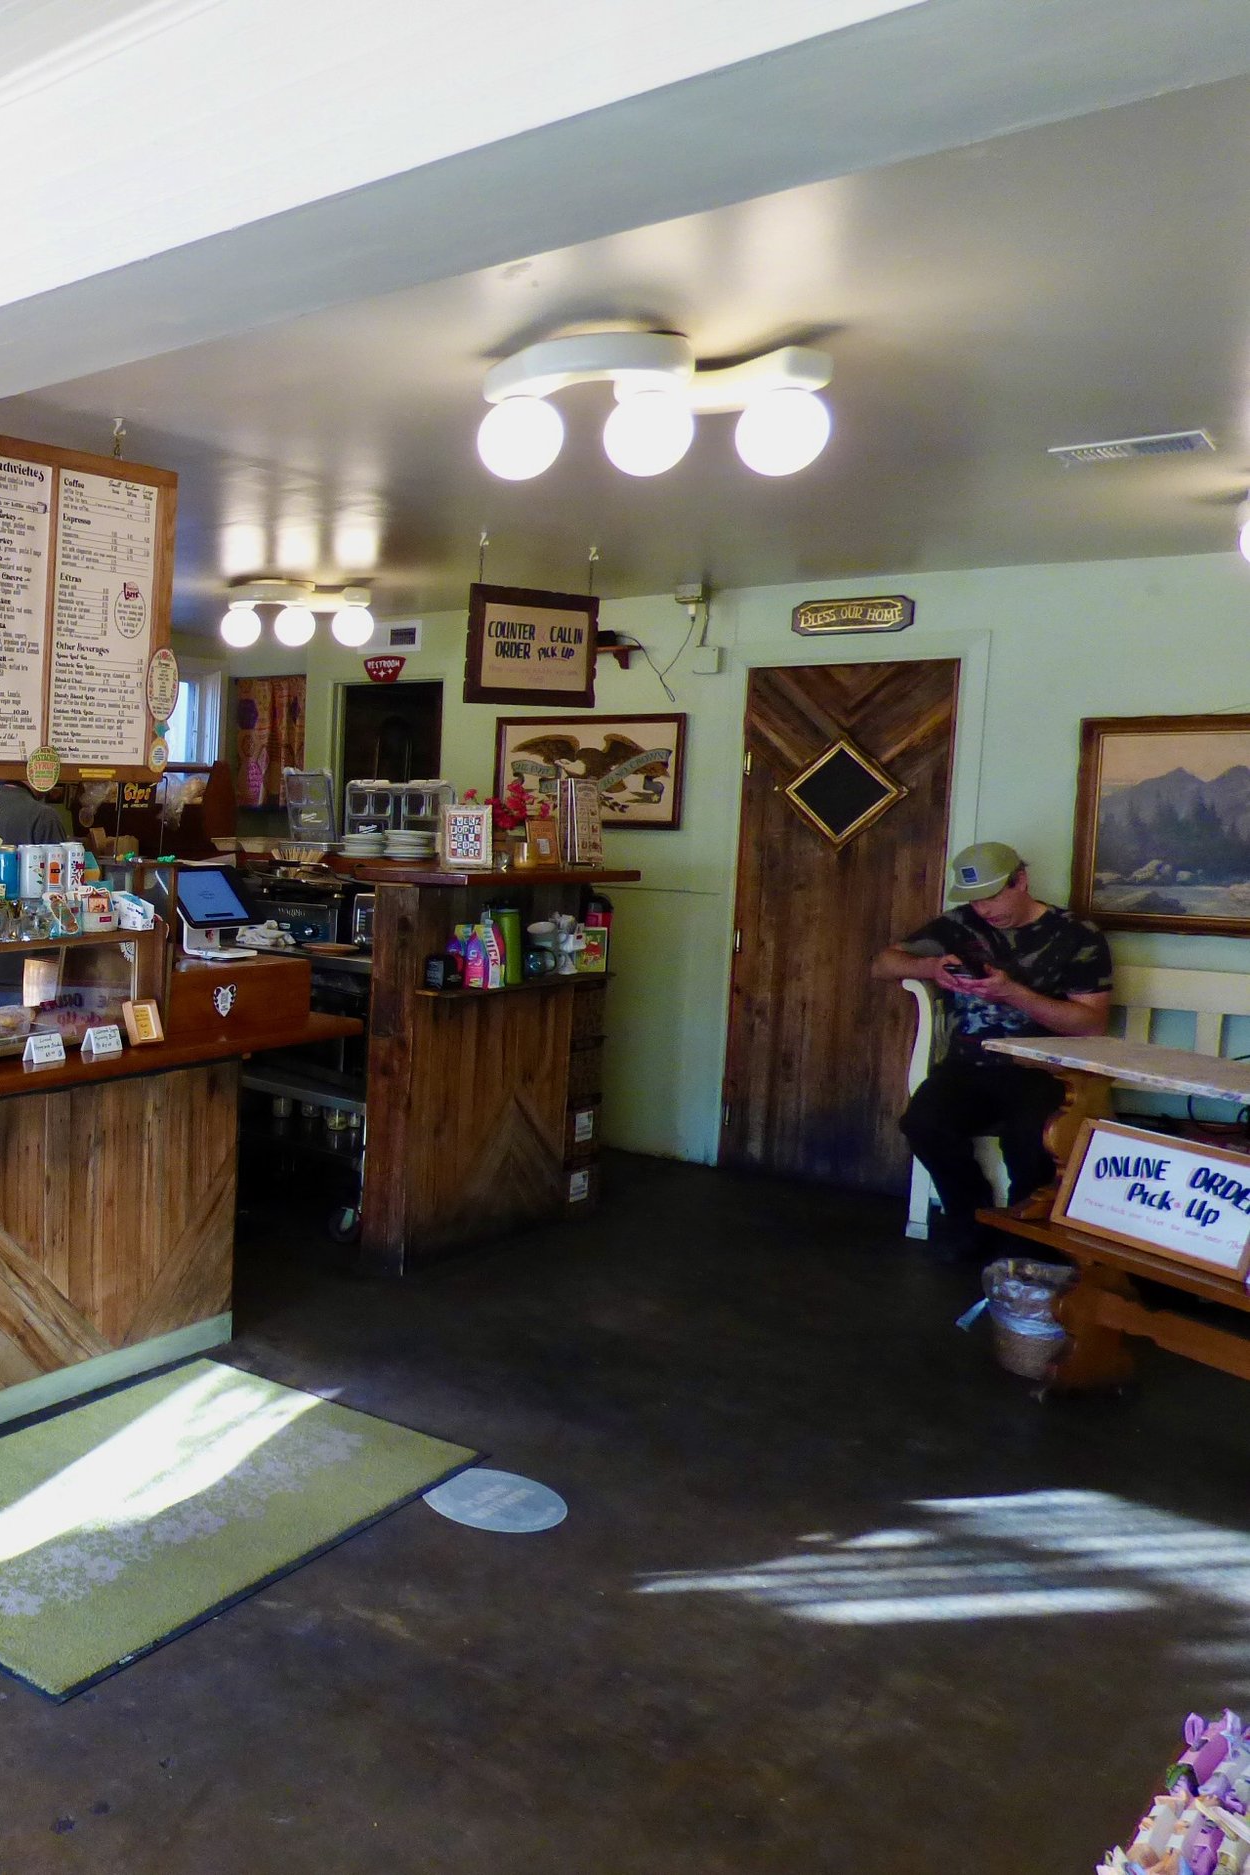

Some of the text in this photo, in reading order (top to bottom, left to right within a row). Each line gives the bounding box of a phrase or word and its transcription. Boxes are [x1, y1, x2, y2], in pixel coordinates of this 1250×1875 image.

[63, 477, 84, 488] Coffee
[62, 513, 91, 526] Espresso
[60, 572, 81, 582] Extras
[800, 606, 904, 627] BLESS OUR HOME
[488, 620, 535, 641] COUNTER
[56, 641, 109, 657] Other Beverages
[495, 641, 531, 660] ORDER
[561, 648, 575, 660] UP
[1093, 1155, 1172, 1182] ONLINE
